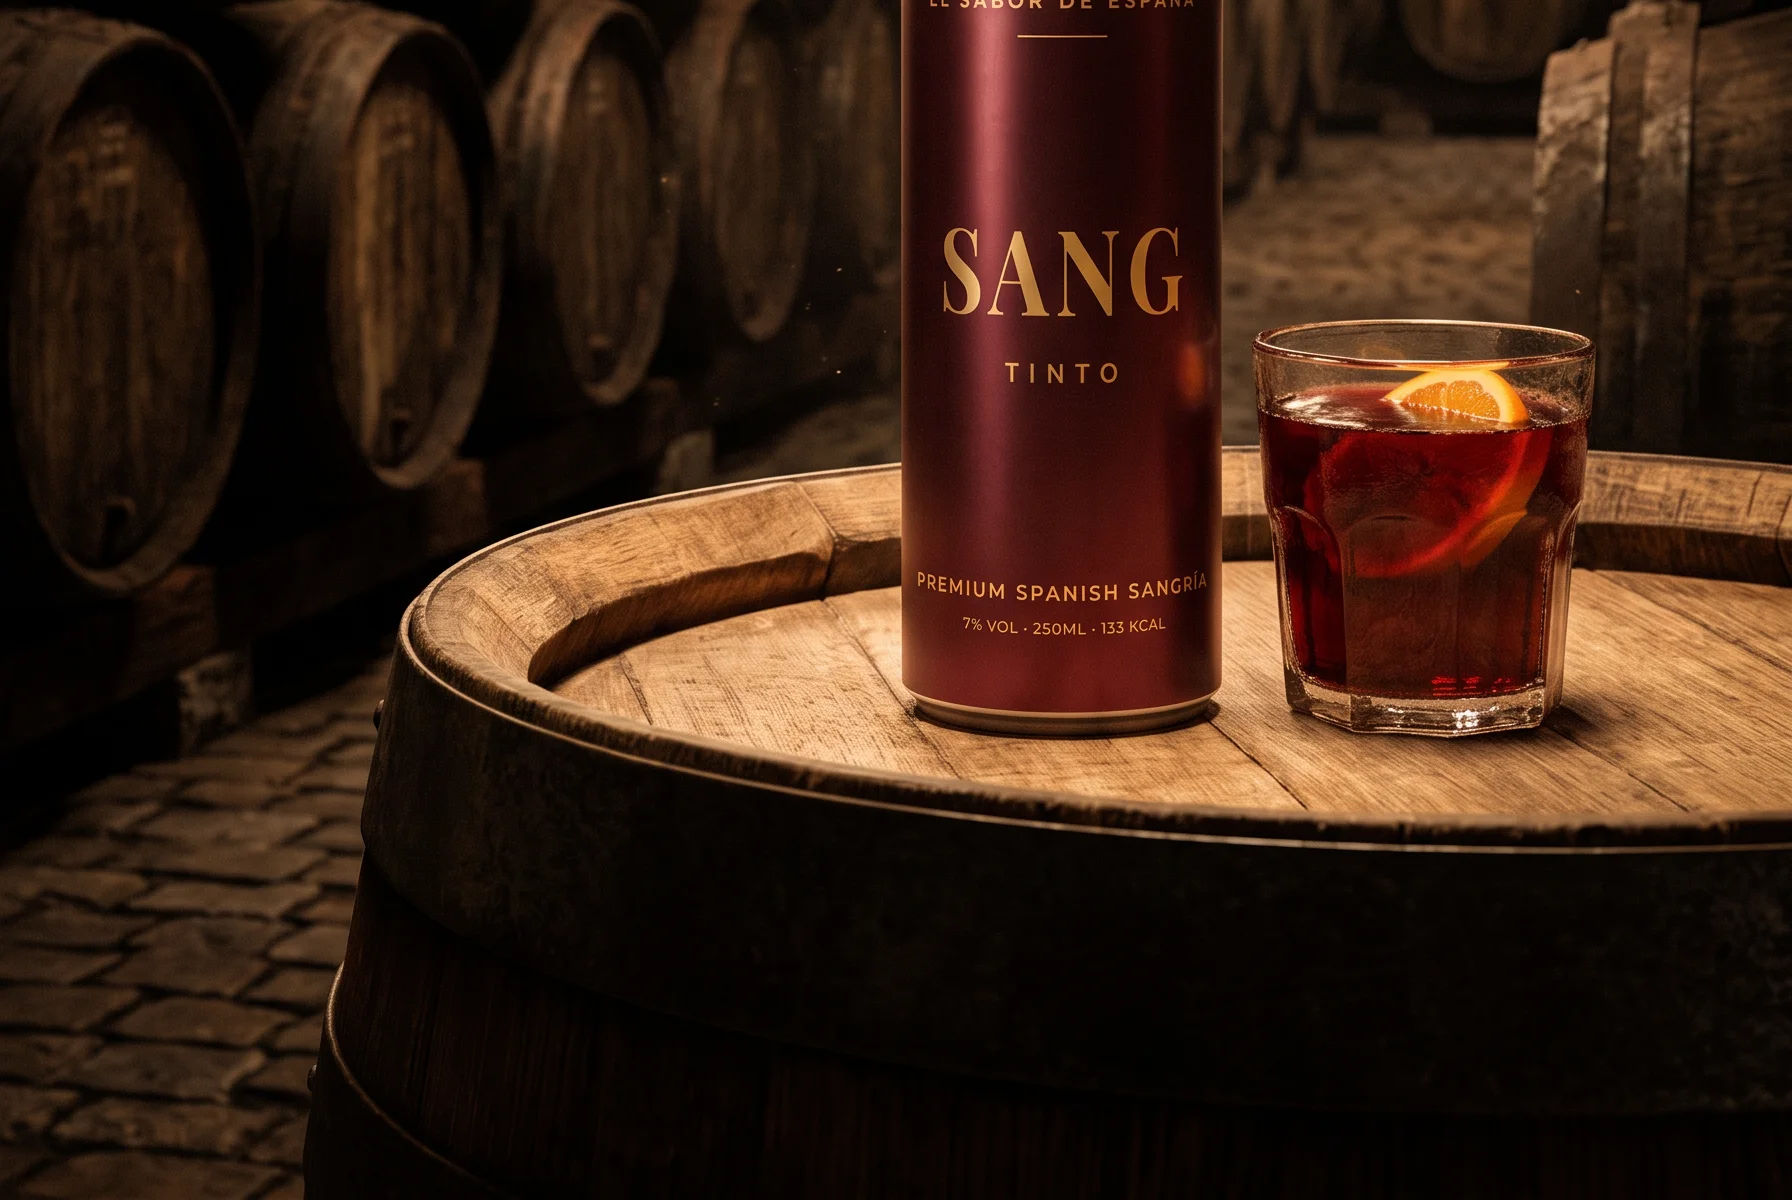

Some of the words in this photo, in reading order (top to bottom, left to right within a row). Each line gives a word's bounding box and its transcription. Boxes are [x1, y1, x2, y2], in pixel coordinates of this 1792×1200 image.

[943, 227, 1183, 317] SANG
[1004, 362, 1118, 384] TINTO
[917, 571, 1005, 600] PREMIUM
[1016, 584, 1118, 602] SPANISH
[1128, 570, 1207, 600] SANGRÍA
[962, 616, 983, 632] 7%
[986, 619, 1018, 634] VOL
[1033, 622, 1086, 636] 250ML
[1101, 621, 1124, 635] 133
[1129, 617, 1166, 633] KCAL
